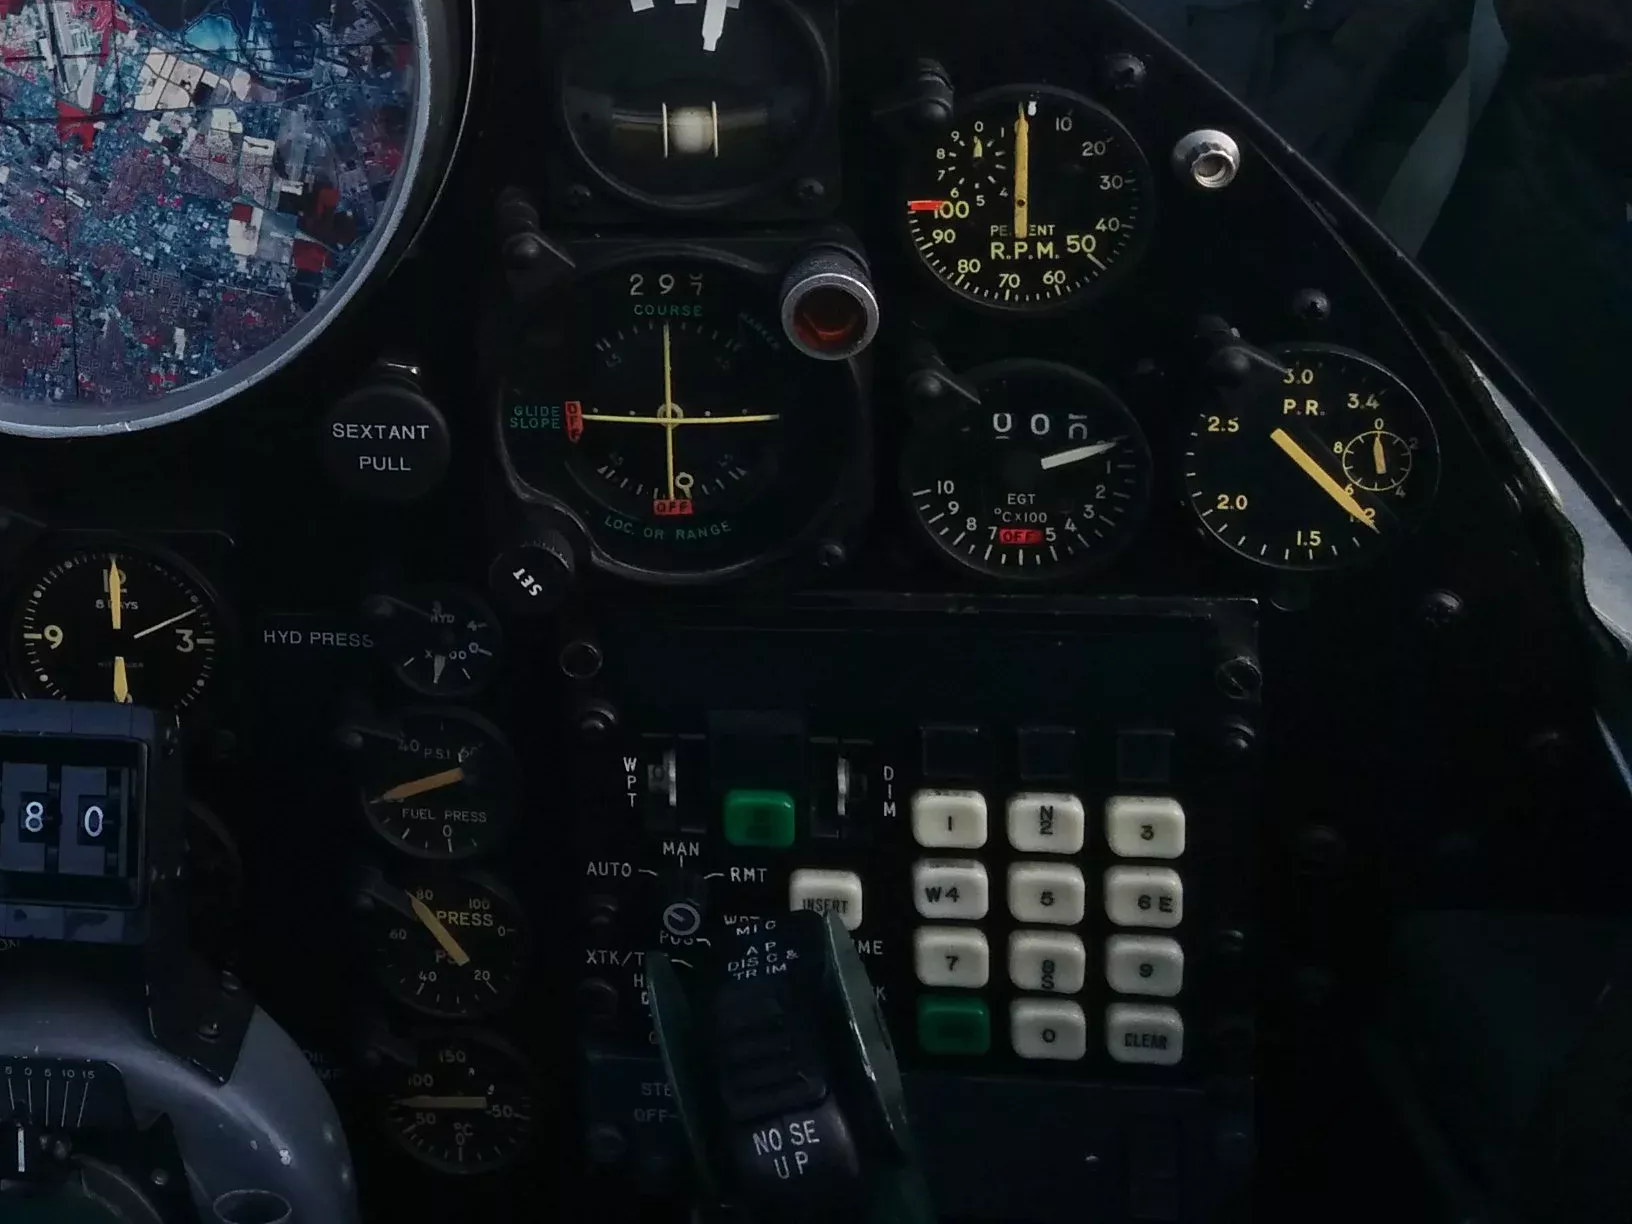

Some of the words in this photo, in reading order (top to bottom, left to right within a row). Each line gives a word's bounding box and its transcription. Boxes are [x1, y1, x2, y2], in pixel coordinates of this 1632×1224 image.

[975, 121, 984, 132] 0
[1056, 117, 1072, 131] 10
[951, 131, 960, 142] 9
[936, 148, 945, 159] 8
[1082, 141, 1106, 156] 20
[937, 170, 945, 181] 7
[1099, 175, 1123, 190] 30
[950, 187, 959, 198] 6
[1000, 188, 1009, 197] 4
[976, 195, 985, 207] 5
[1095, 217, 1120, 231] 40
[932, 229, 956, 244] 90
[990, 241, 1060, 260] R.P.M.
[1067, 235, 1096, 253] 50
[957, 258, 981, 273] 80
[999, 274, 1020, 288] 70
[1043, 270, 1066, 284] 60
[634, 304, 703, 317] COURSE
[1283, 368, 1313, 384] 3.0
[1283, 399, 1326, 416] P.R.
[1347, 393, 1380, 409] 3.4
[514, 406, 560, 417] GLIDE
[510, 418, 560, 429] SLOPE
[1208, 416, 1239, 432] 2.5
[1374, 418, 1384, 429] 0
[331, 423, 430, 442] SEXTANT
[1333, 441, 1343, 453] 8
[357, 455, 412, 472] PULL
[937, 480, 954, 494] 10
[1096, 484, 1106, 499] 2
[1008, 494, 1036, 505] EGT
[1217, 494, 1248, 510] 2.0
[656, 502, 690, 513] OFF
[947, 501, 959, 515] 9
[1083, 504, 1095, 519] 3
[644, 528, 664, 540] OR
[676, 521, 731, 540] RANGE
[966, 517, 977, 531] 8
[1064, 518, 1077, 532] 4
[988, 526, 998, 540] 7
[1003, 531, 1034, 542] OFF
[1045, 528, 1056, 542] 5
[1296, 530, 1321, 546] 1.5
[512, 568, 543, 596] SET
[43, 625, 64, 650] 9
[175, 629, 195, 653] 3
[262, 630, 306, 647] HYD
[309, 631, 375, 649] PRESS
[402, 808, 436, 820] FUEL
[445, 810, 488, 823] PRESS
[1040, 806, 1053, 820] N
[443, 825, 452, 838] 0
[1040, 820, 1053, 835] 2
[1141, 825, 1154, 840] 3
[663, 842, 700, 857] MAN
[586, 863, 632, 878] AUTO
[730, 866, 767, 884] RMT
[802, 898, 848, 914] INSERT
[1040, 892, 1054, 906] 5
[436, 910, 494, 927] PRESS
[946, 955, 959, 971] 7
[1042, 960, 1055, 974] 8
[418, 970, 438, 982] 40
[474, 970, 491, 981] 20
[1139, 964, 1153, 978] 9
[1041, 975, 1054, 989] S
[1042, 1029, 1056, 1043] 0
[1125, 1033, 1167, 1050] CLEAR
